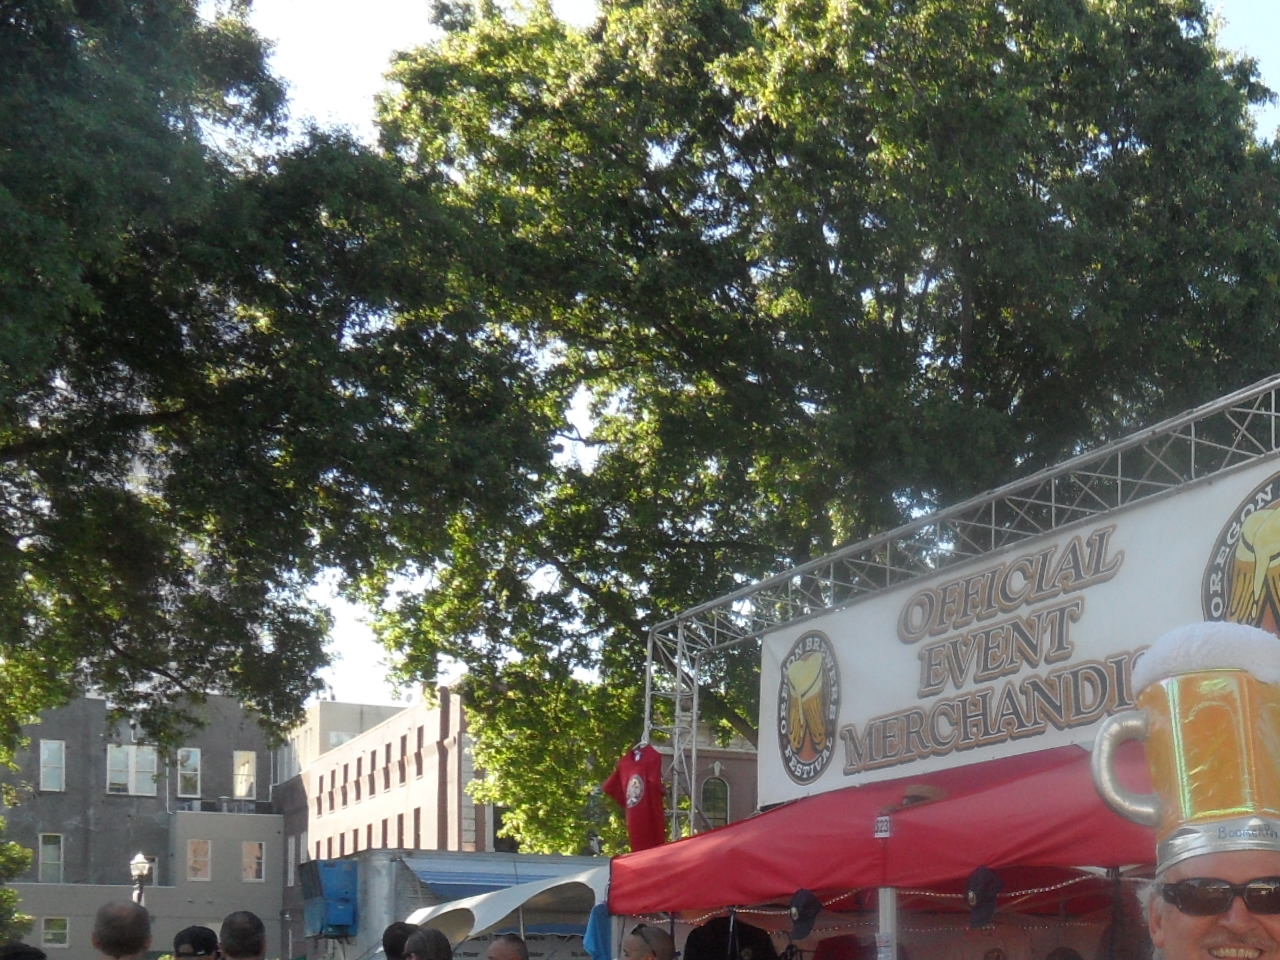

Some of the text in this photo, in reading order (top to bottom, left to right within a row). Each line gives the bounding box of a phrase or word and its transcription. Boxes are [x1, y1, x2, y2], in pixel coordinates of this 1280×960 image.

[898, 525, 1124, 645] OFFICIAL
[1209, 485, 1273, 618] OREGON
[917, 597, 1084, 699] EVENT
[840, 645, 1150, 778] MERCHANDI
